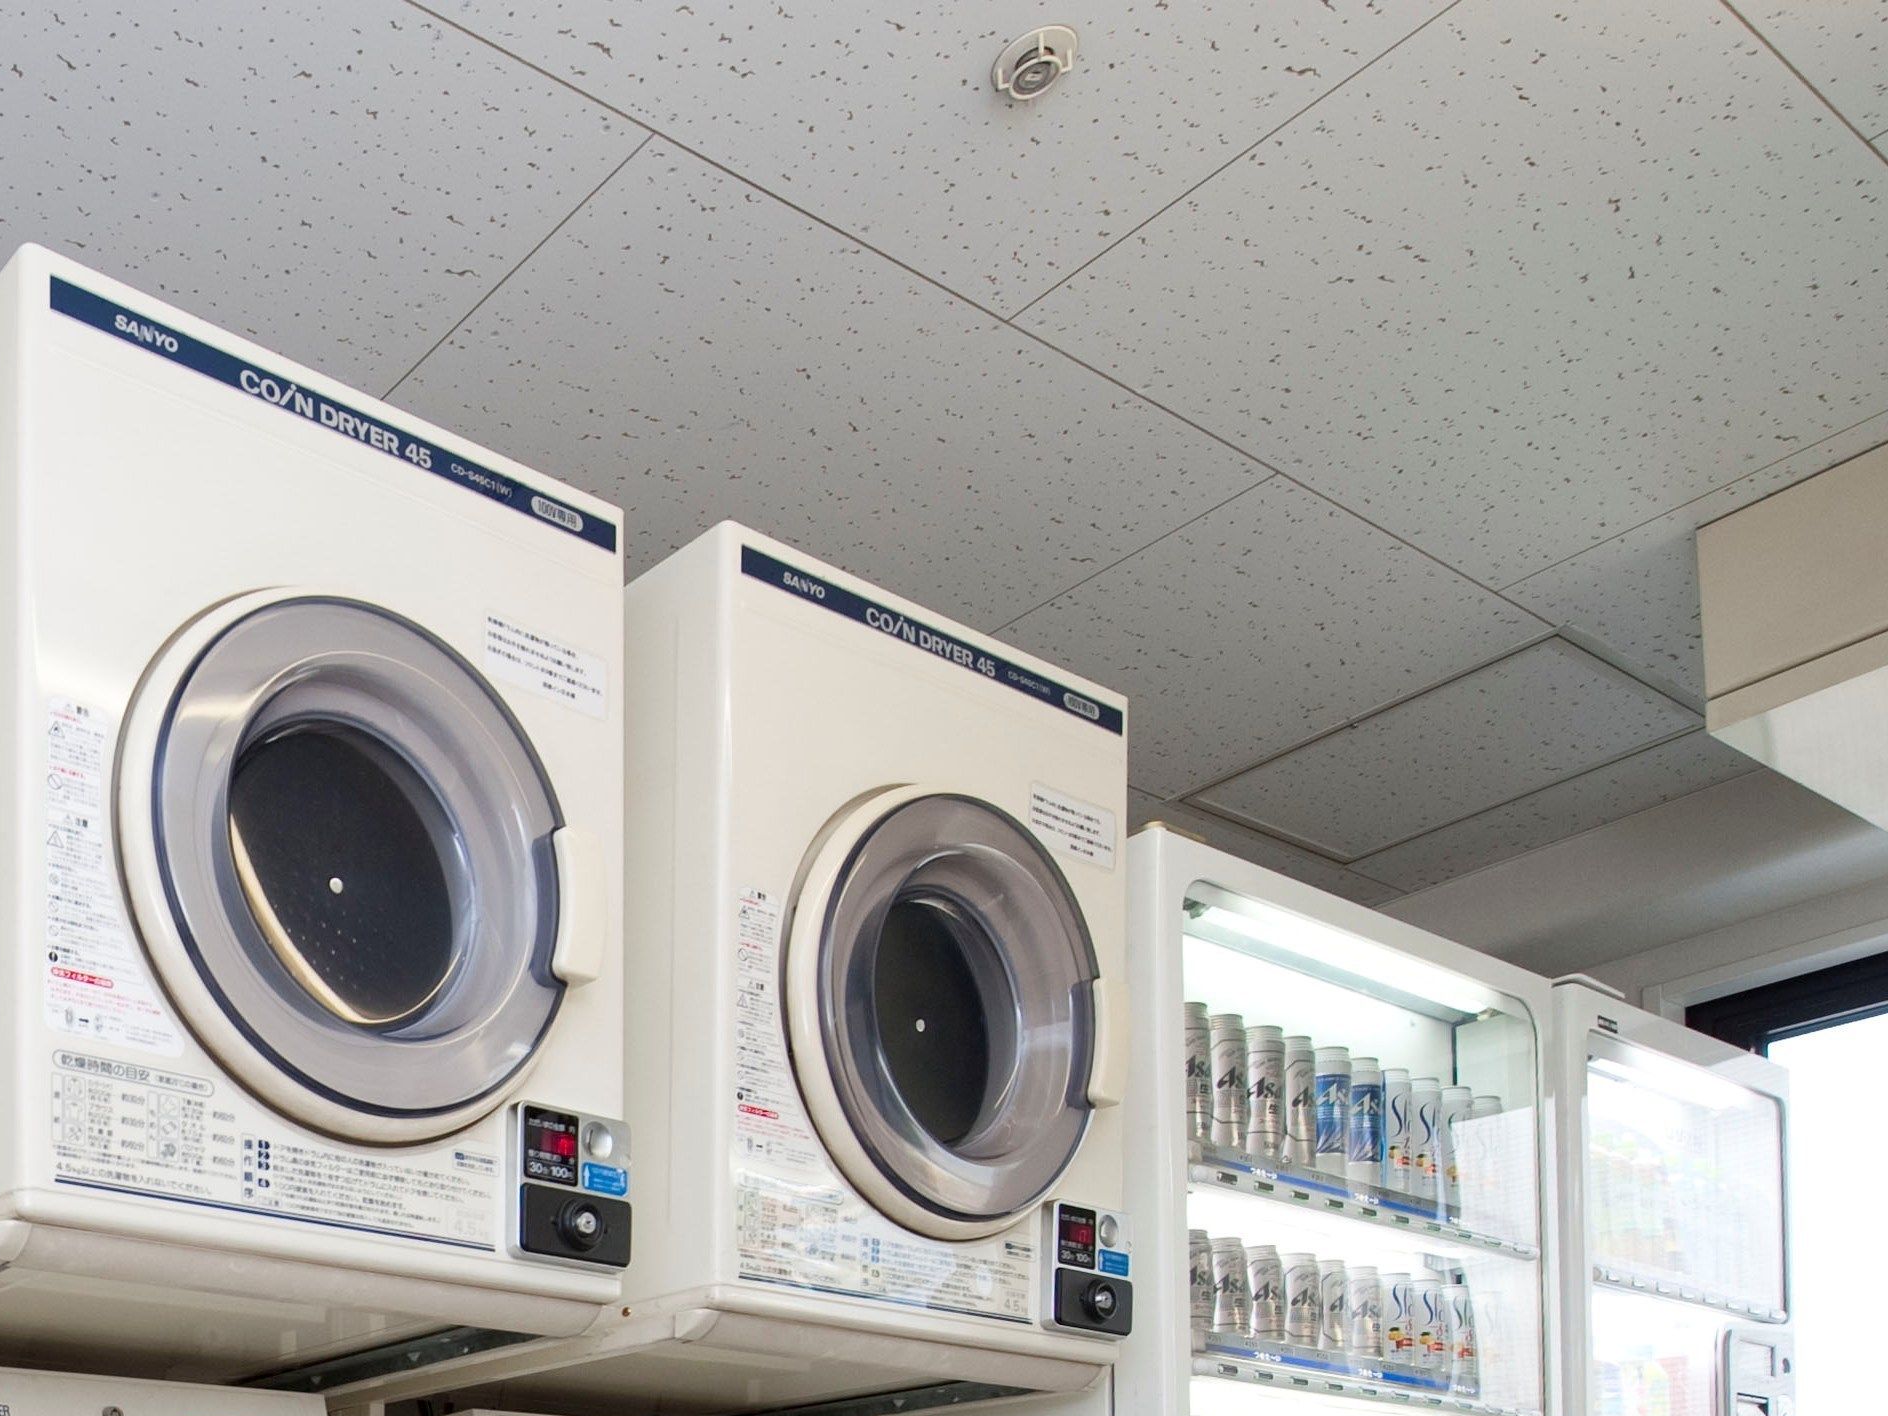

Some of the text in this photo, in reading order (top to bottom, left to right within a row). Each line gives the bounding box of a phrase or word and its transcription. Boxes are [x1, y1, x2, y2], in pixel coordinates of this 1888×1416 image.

[114, 313, 179, 354] SANYO
[320, 402, 400, 456] DRYER
[404, 443, 432, 470] 45
[783, 571, 826, 599] SANYO
[919, 629, 974, 669] DRYER
[976, 656, 996, 678] 45
[61, 1053, 150, 1082] 乾燥時間の目安
